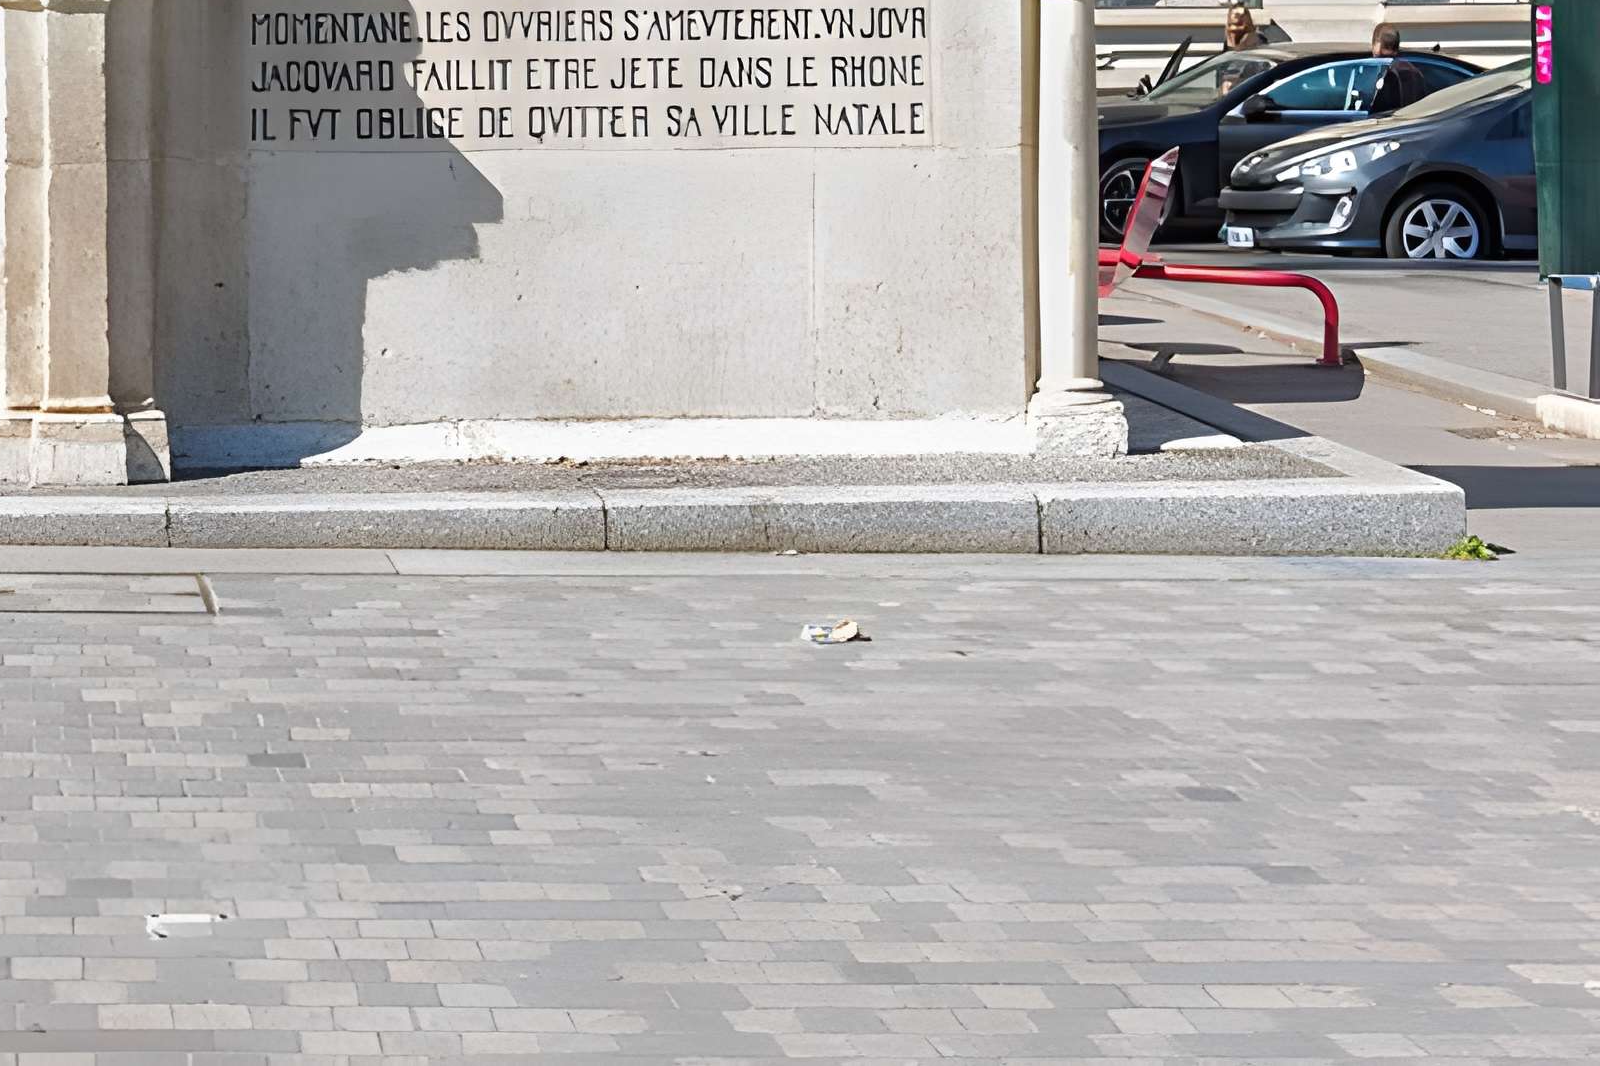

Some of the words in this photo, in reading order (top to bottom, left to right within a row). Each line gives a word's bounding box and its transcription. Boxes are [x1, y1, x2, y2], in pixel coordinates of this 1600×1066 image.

[426, 11, 471, 43] LES
[411, 59, 513, 91] FAILLIT
[526, 58, 599, 90] ETRE
[610, 57, 684, 89] JETE
[699, 56, 773, 88] DANS
[786, 56, 818, 87] LE
[831, 55, 925, 87] RHONE
[251, 108, 277, 141] IL
[356, 107, 465, 139] OBLIGE
[479, 106, 514, 138] DE
[666, 105, 702, 137] SA
[712, 104, 797, 136] VILLE
[814, 102, 925, 135] NATALE
